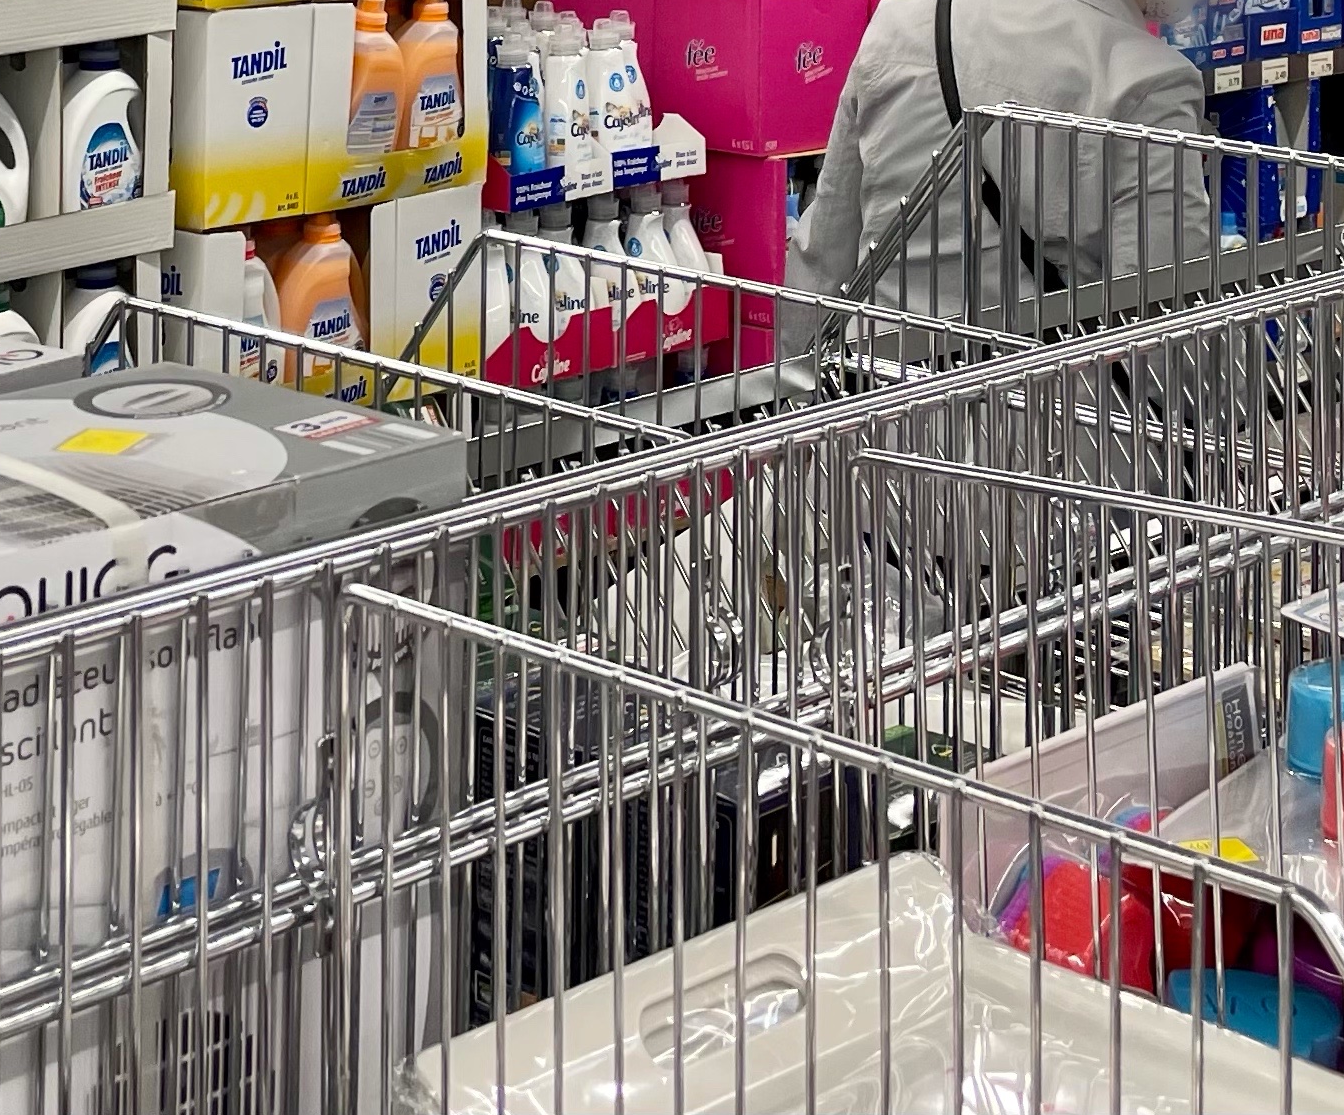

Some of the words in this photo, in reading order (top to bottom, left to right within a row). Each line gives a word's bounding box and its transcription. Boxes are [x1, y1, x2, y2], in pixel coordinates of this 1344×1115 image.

[1263, 25, 1286, 42] una
[231, 40, 288, 80] TANDIL
[685, 39, 717, 68] fée
[419, 84, 457, 112] TANDIL
[88, 141, 130, 172] TANDIL
[423, 151, 463, 185] TANDIL
[341, 166, 387, 199] TANDIL
[415, 219, 463, 260] TANDIL
[311, 309, 352, 338] TANDIL
[1230, 699, 1250, 768] Home
